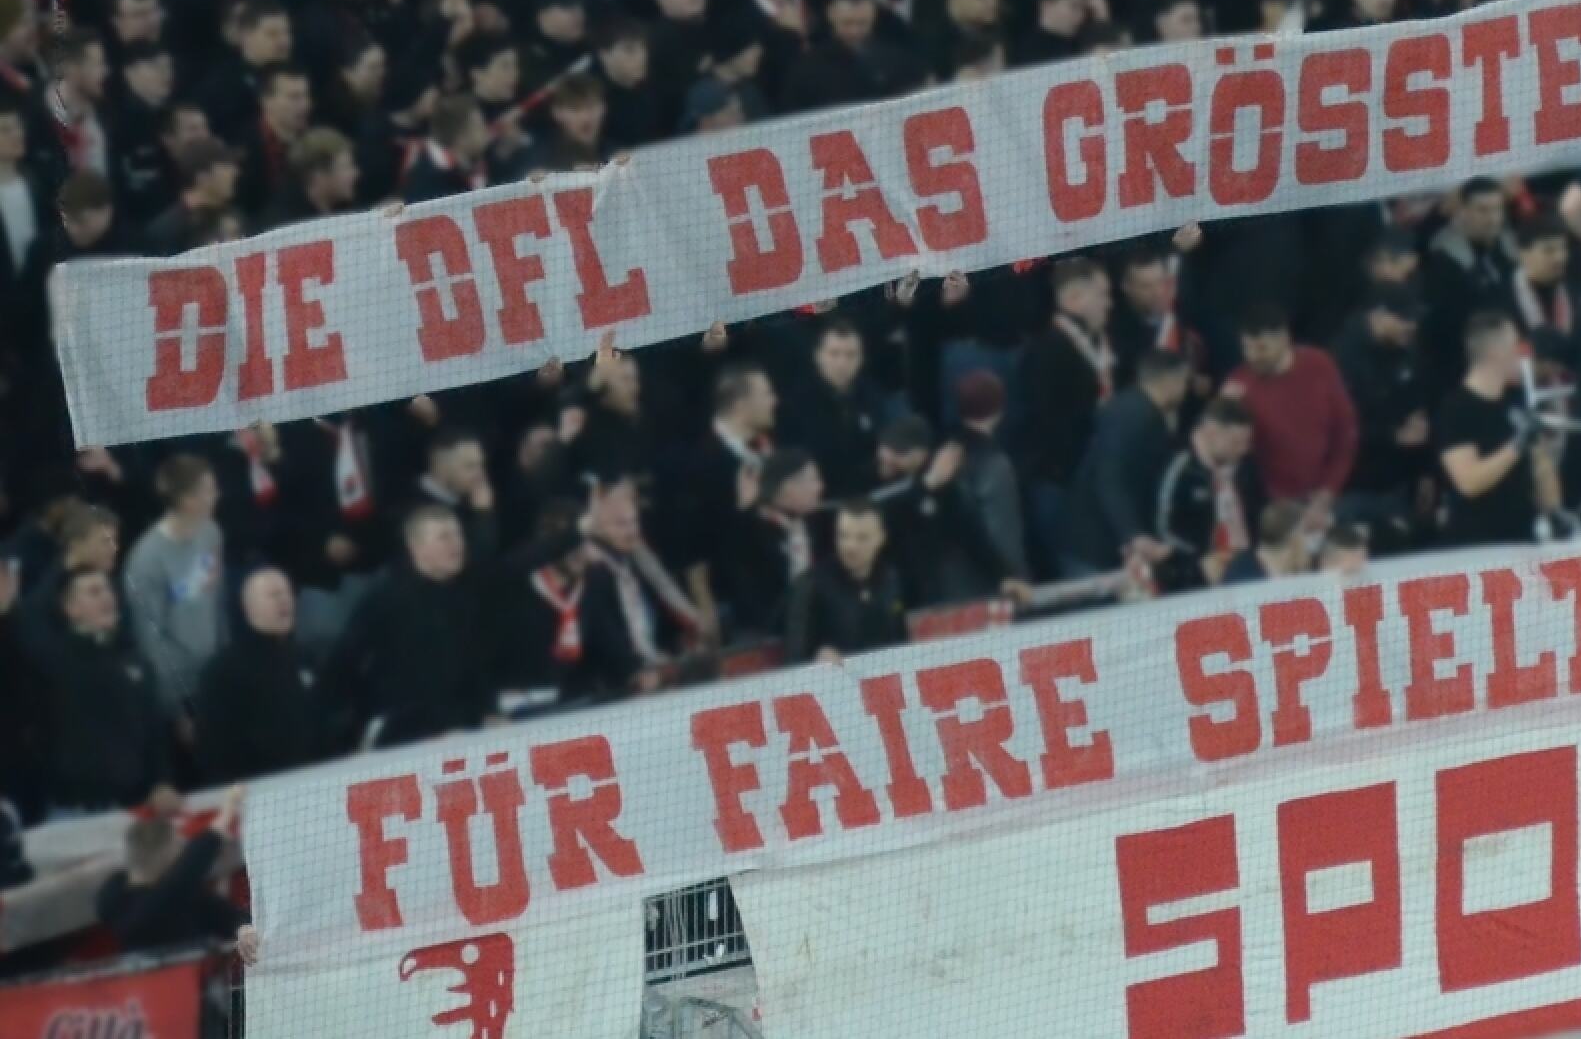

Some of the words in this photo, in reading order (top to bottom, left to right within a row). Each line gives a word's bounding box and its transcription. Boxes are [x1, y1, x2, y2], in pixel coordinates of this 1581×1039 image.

[145, 239, 348, 412] DIE
[396, 187, 652, 362] DFL
[706, 106, 989, 296] DAS
[346, 734, 645, 931] FÜR
[690, 638, 1114, 853] FAIRE
